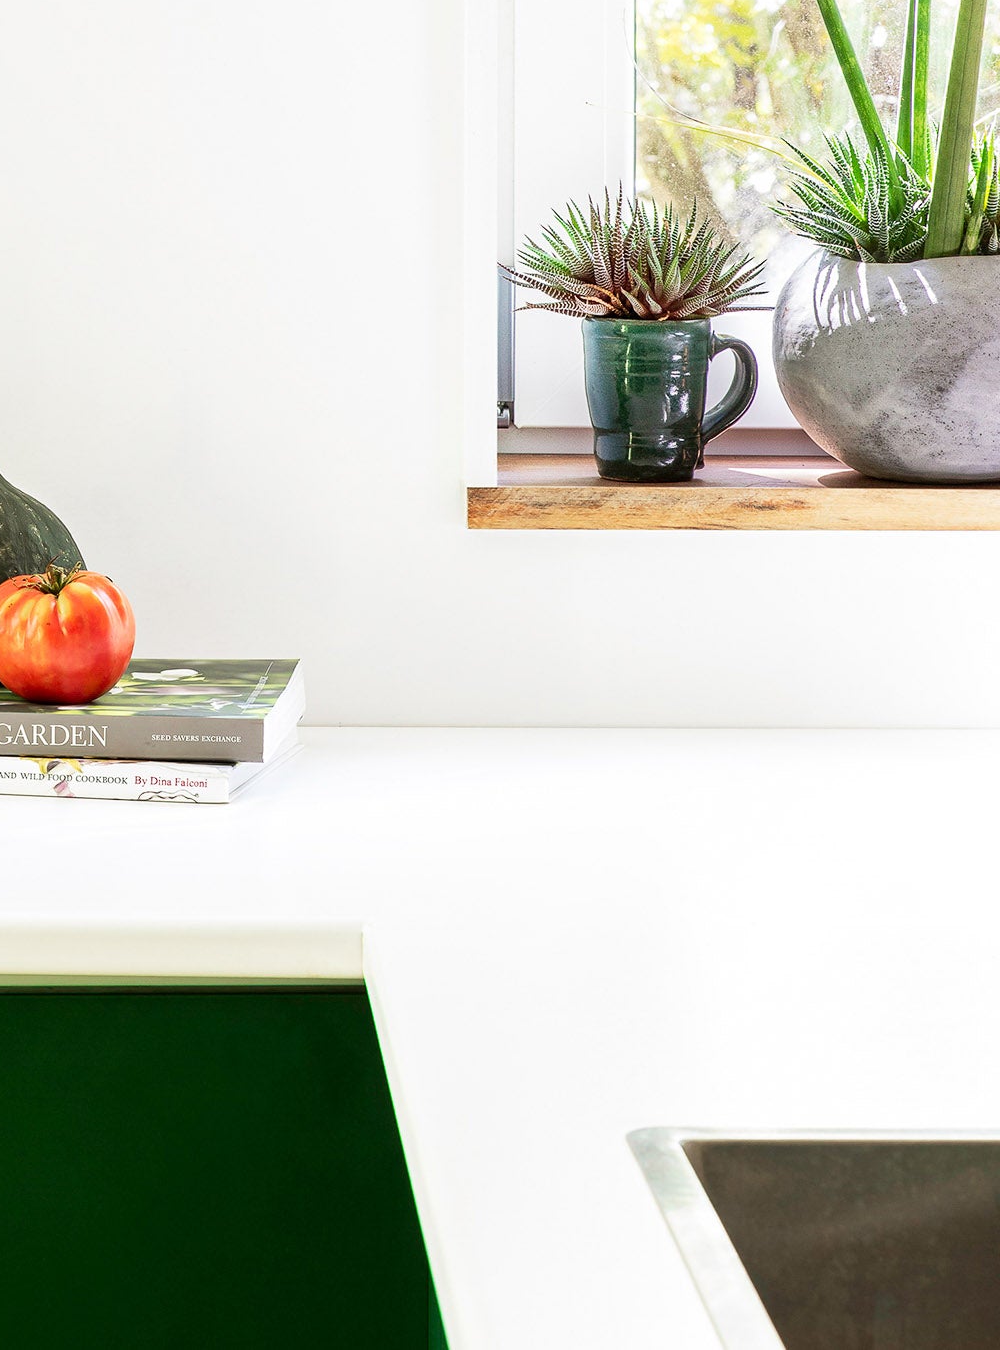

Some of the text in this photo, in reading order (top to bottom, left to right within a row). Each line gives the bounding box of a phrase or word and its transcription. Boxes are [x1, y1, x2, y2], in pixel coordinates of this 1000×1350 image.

[151, 734, 242, 744] SEED SAVERS EXCHANGE
[20, 772, 45, 782] WILD
[47, 773, 73, 783] FOOD
[75, 774, 129, 786] COOKBOOK
[134, 776, 148, 787] By
[150, 776, 172, 787] Dina
[174, 777, 208, 789] Falconi
